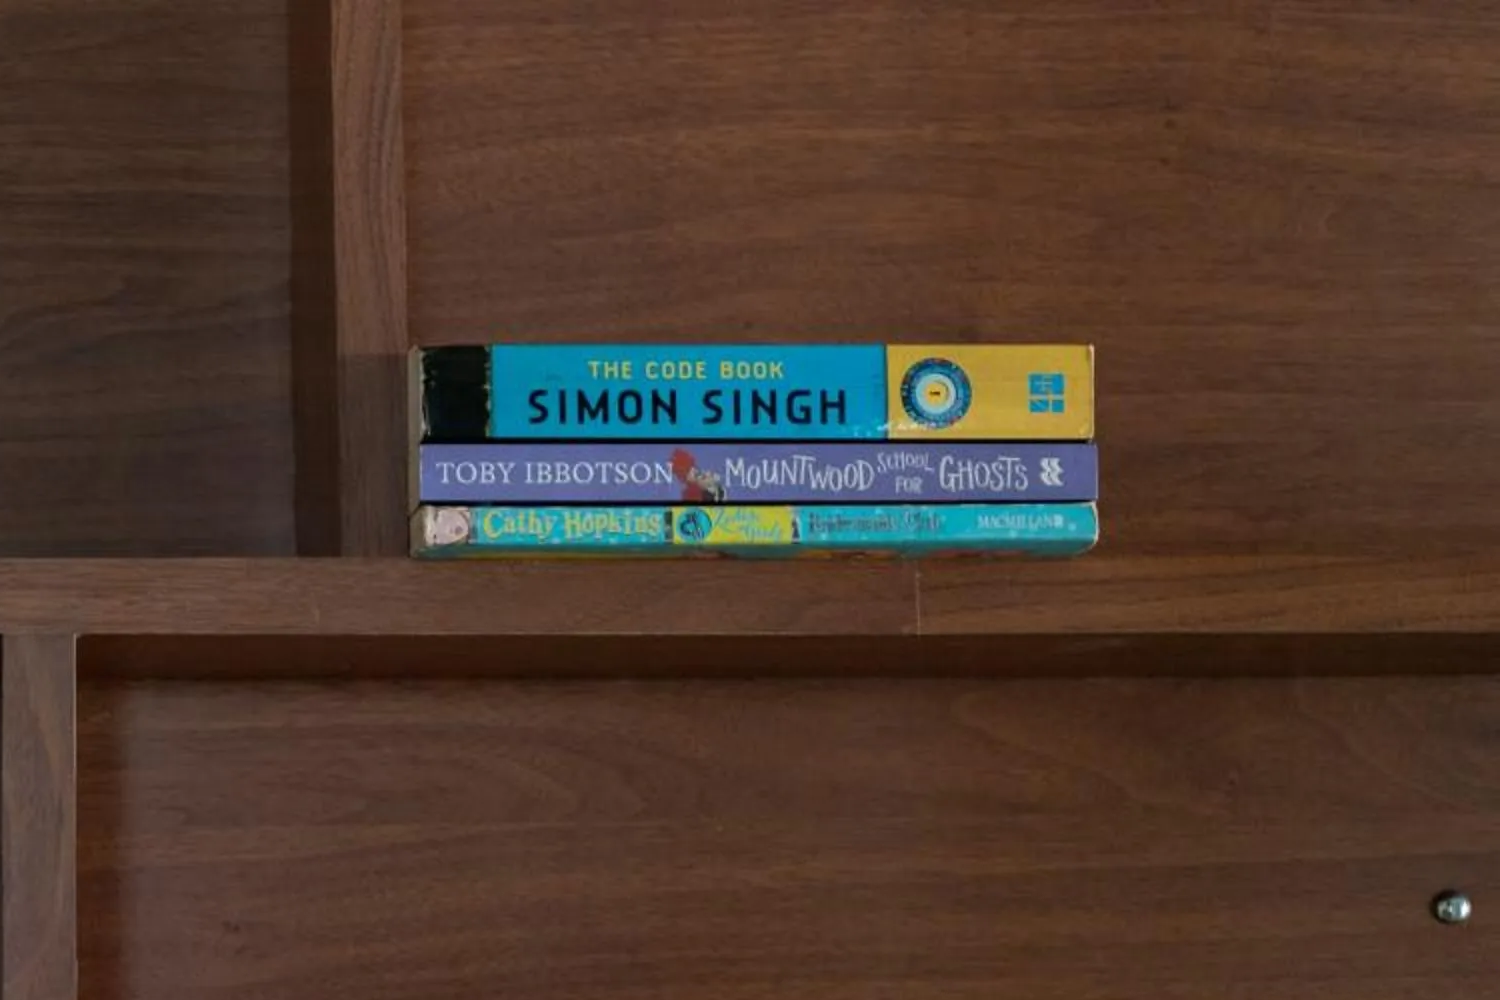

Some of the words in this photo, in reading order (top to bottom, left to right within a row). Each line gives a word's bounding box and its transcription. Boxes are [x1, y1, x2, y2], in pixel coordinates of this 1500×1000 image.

[588, 361, 632, 379] THE
[645, 361, 707, 379] CODE
[720, 361, 785, 379] BOOK
[528, 389, 678, 425] SIMON
[702, 389, 846, 425] SINGH
[435, 462, 515, 485] TOBY
[524, 462, 674, 485] IBBOTSON
[895, 476, 923, 494] FOR
[483, 511, 557, 539] Cathy
[563, 509, 662, 539] Hopkins
